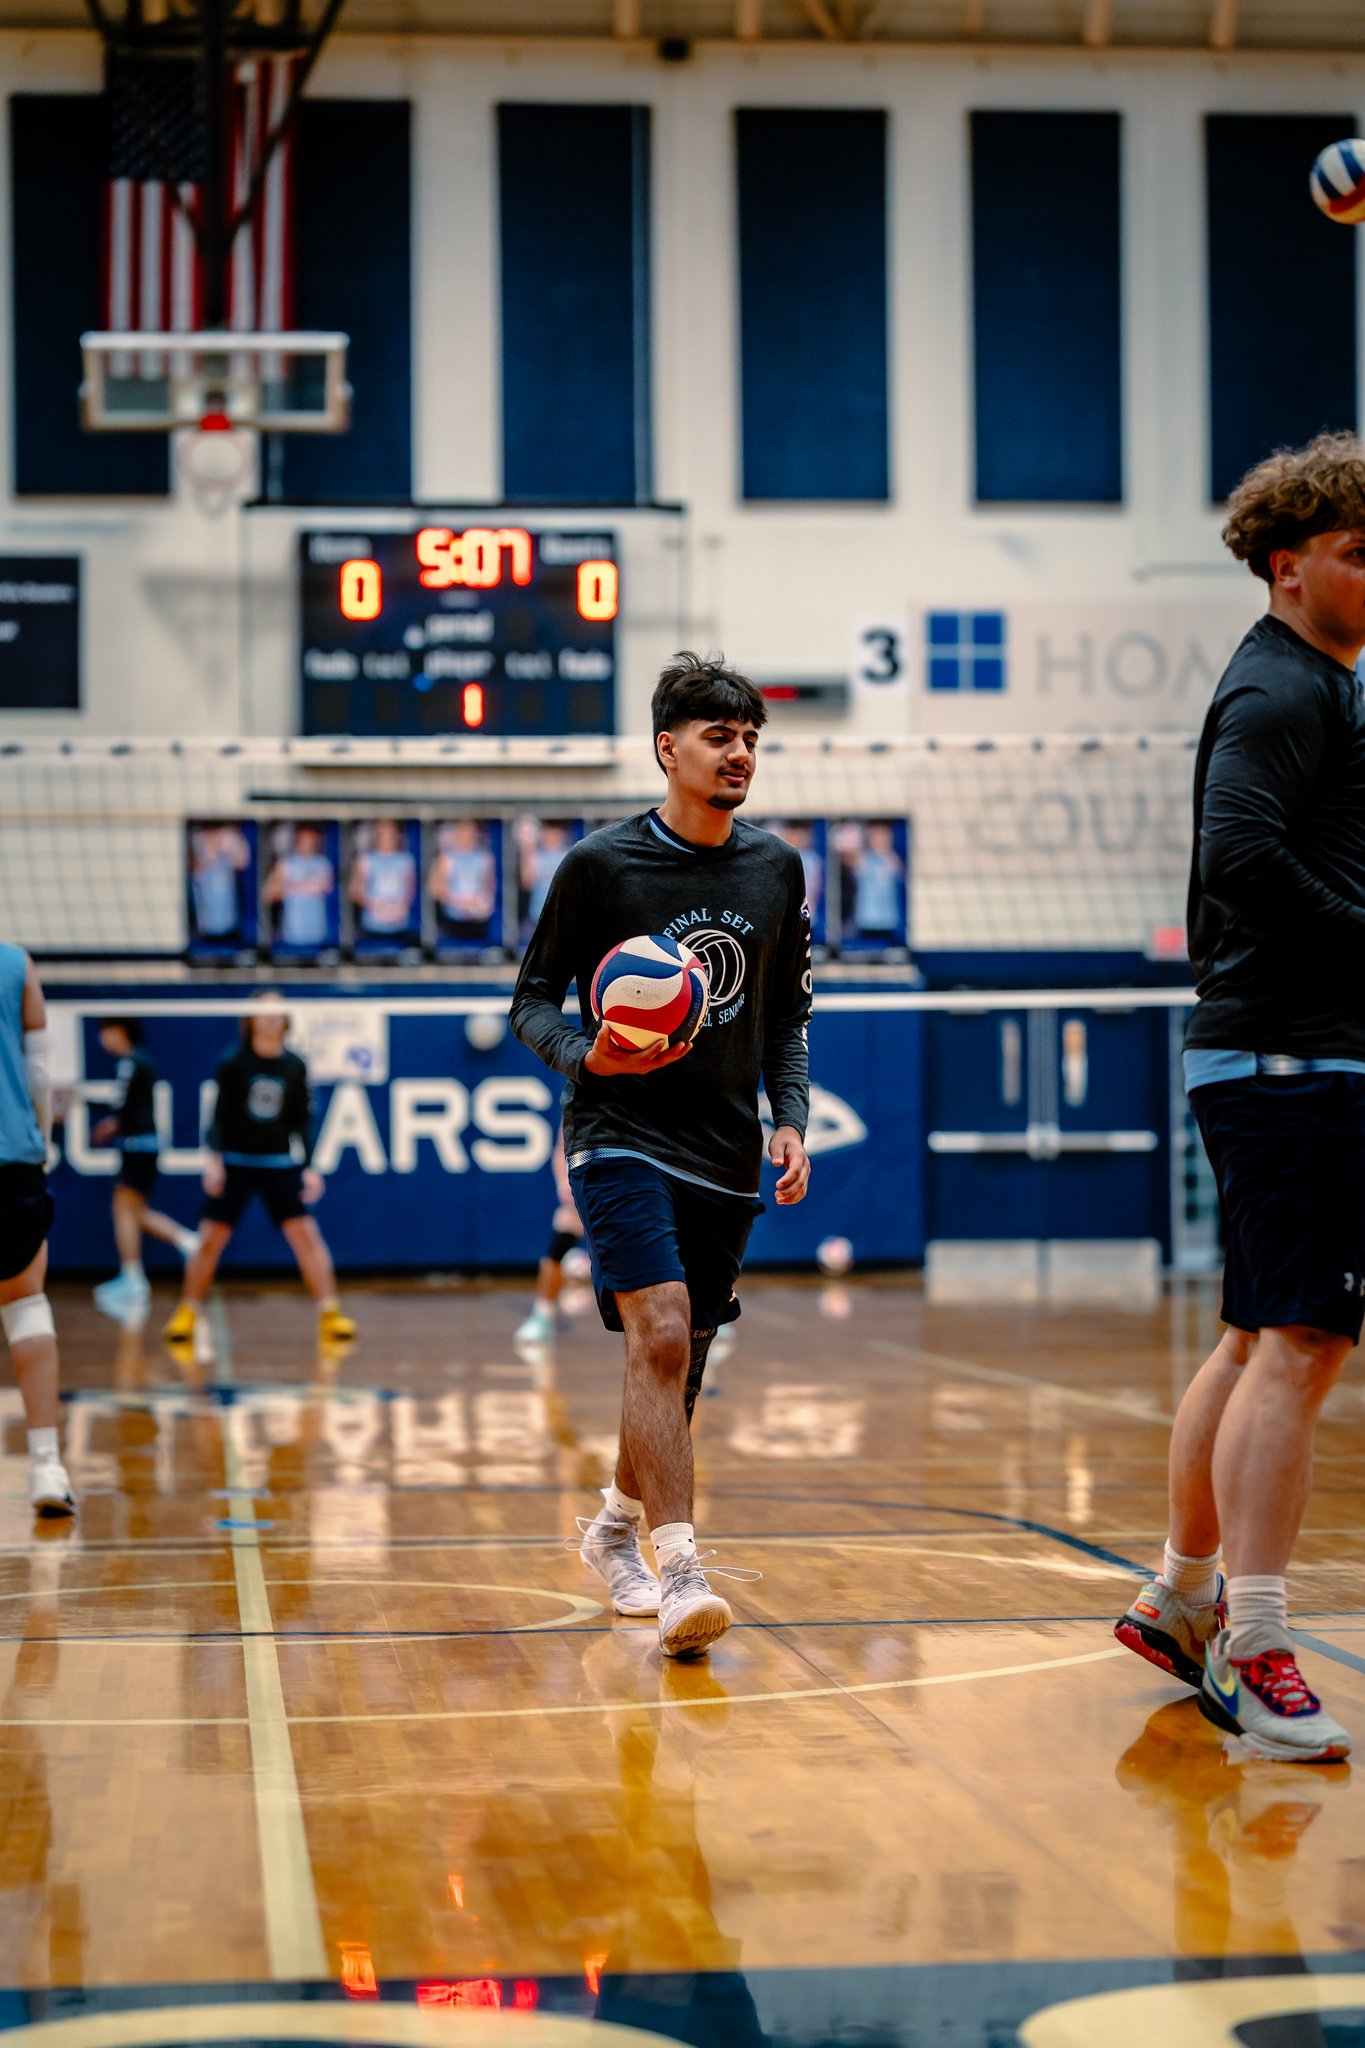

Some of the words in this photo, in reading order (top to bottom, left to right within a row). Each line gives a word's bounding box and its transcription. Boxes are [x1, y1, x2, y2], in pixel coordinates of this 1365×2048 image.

[416, 528, 532, 588] 5:07
[340, 559, 382, 621] 0
[577, 559, 619, 621] 0
[860, 626, 902, 685] 3
[462, 682, 484, 728] 1
[662, 907, 712, 940] FINAL
[720, 909, 754, 936] SET
[43, 1076, 552, 1175] OUARS
